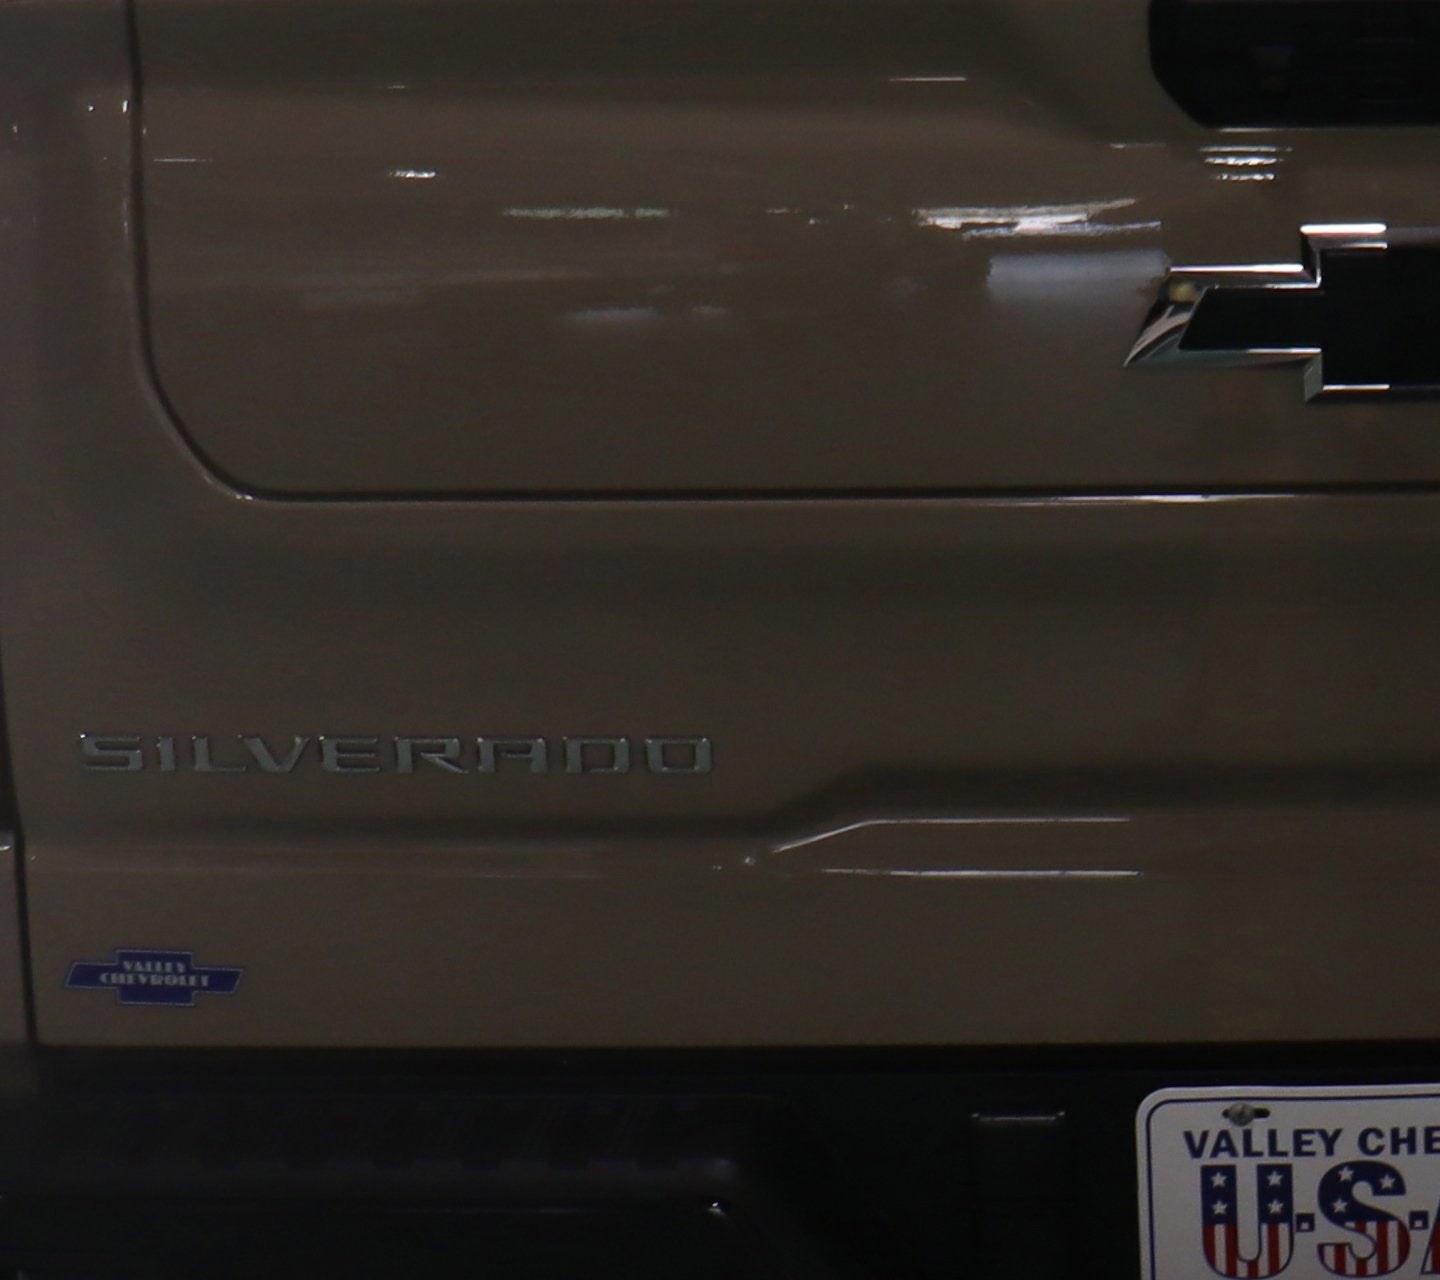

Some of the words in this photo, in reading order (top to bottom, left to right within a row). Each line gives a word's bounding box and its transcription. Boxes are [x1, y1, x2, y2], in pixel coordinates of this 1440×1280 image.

[79, 732, 714, 774] SILVERADO
[122, 960, 188, 974] VALLEY
[99, 972, 210, 988] CHEVROLET
[1183, 1128, 1343, 1160] VALLEY
